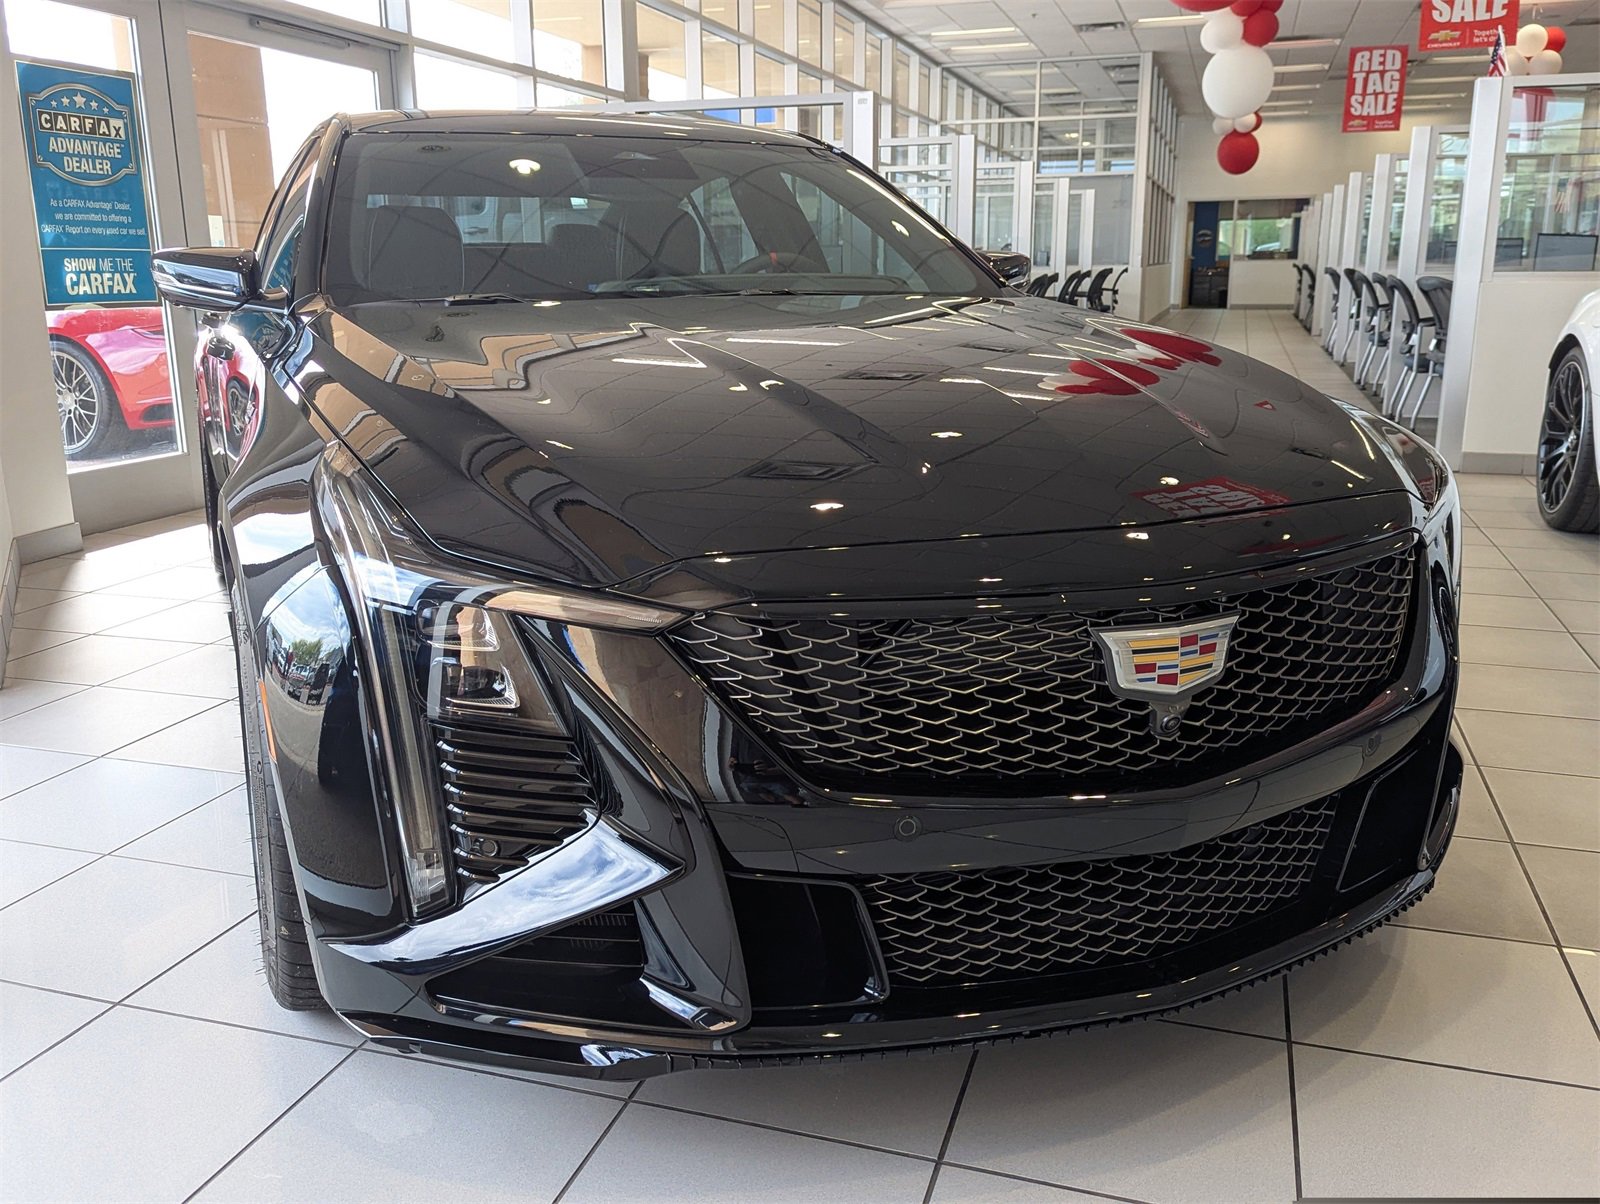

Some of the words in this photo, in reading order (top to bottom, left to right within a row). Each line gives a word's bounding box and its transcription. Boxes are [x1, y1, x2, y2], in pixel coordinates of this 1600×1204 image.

[1431, 0, 1509, 23] SALE
[1353, 49, 1402, 72] RED
[1352, 71, 1401, 94] TAG
[1350, 93, 1398, 116] SALE
[41, 113, 123, 139] CARFAX
[49, 136, 122, 158] ADVANTAGE
[63, 156, 113, 175] DEALER
[50, 199, 58, 207] As
[63, 199, 86, 208] CARFAX
[74, 213, 102, 221] committed
[108, 214, 128, 224] offering
[41, 224, 63, 233] CARFAX
[65, 225, 83, 234] Report
[92, 227, 106, 236] every
[106, 227, 119, 235] used
[63, 257, 96, 272] SHOW
[98, 258, 115, 272] ME
[115, 258, 134, 272] THE
[65, 272, 137, 296] CARFAX
